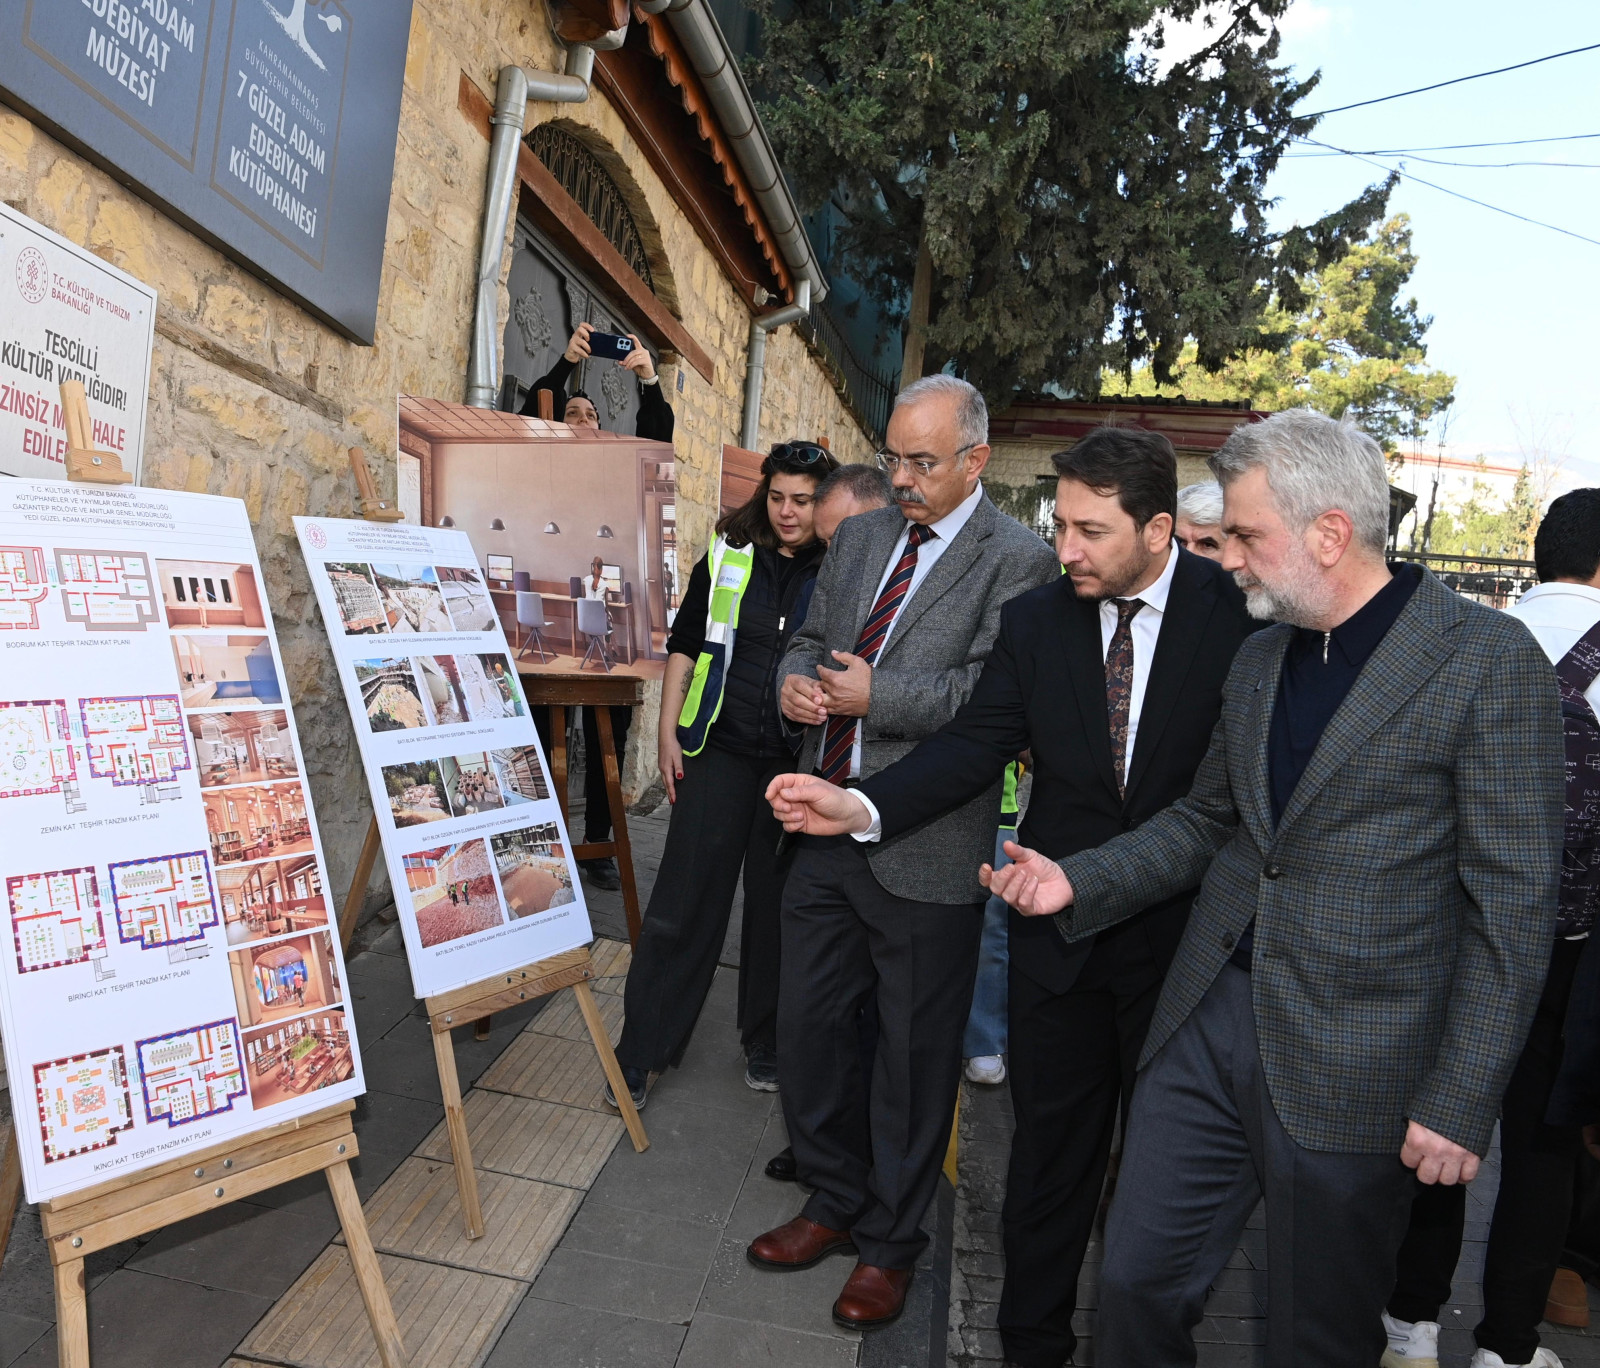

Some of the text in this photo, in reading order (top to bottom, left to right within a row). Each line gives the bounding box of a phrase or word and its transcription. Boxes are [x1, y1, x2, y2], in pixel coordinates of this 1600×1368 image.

[86, 26, 156, 108] MÜZESİ
[259, 39, 319, 110] KAHRAMANMARAŞ
[245, 48, 326, 135] BÜYÜKŞEHİR BELEDİYESİ
[237, 69, 325, 175] 7 GÜZEL ADAM
[249, 122, 309, 194] EDEBİYAT
[229, 145, 317, 238] KÜTÜPHANESİ
[51, 287, 91, 315] BAKANLIĞI
[53, 273, 131, 321] T.C. KÜLTÜR VE TURİZM
[1, 341, 53, 382] KÜLTÜR
[45, 329, 98, 371] TESCİLLİ
[52, 404, 126, 451] MHALE
[112, 500, 132, 508] GENEL
[116, 509, 136, 517] GENEL
[5, 641, 36, 649] BODRUM
[51, 640, 75, 648] TEŞHİR
[40, 825, 62, 834] ZEMİN
[79, 820, 103, 829] TEŞHİR
[105, 817, 128, 825] TANZİM
[68, 969, 191, 1002] BİRİNCİ KAT TEŞHİR TANZİM KAT PLANI
[93, 1129, 212, 1172] İKİNCİ KAT TEŞHİR TANZİM KAT PLANI
